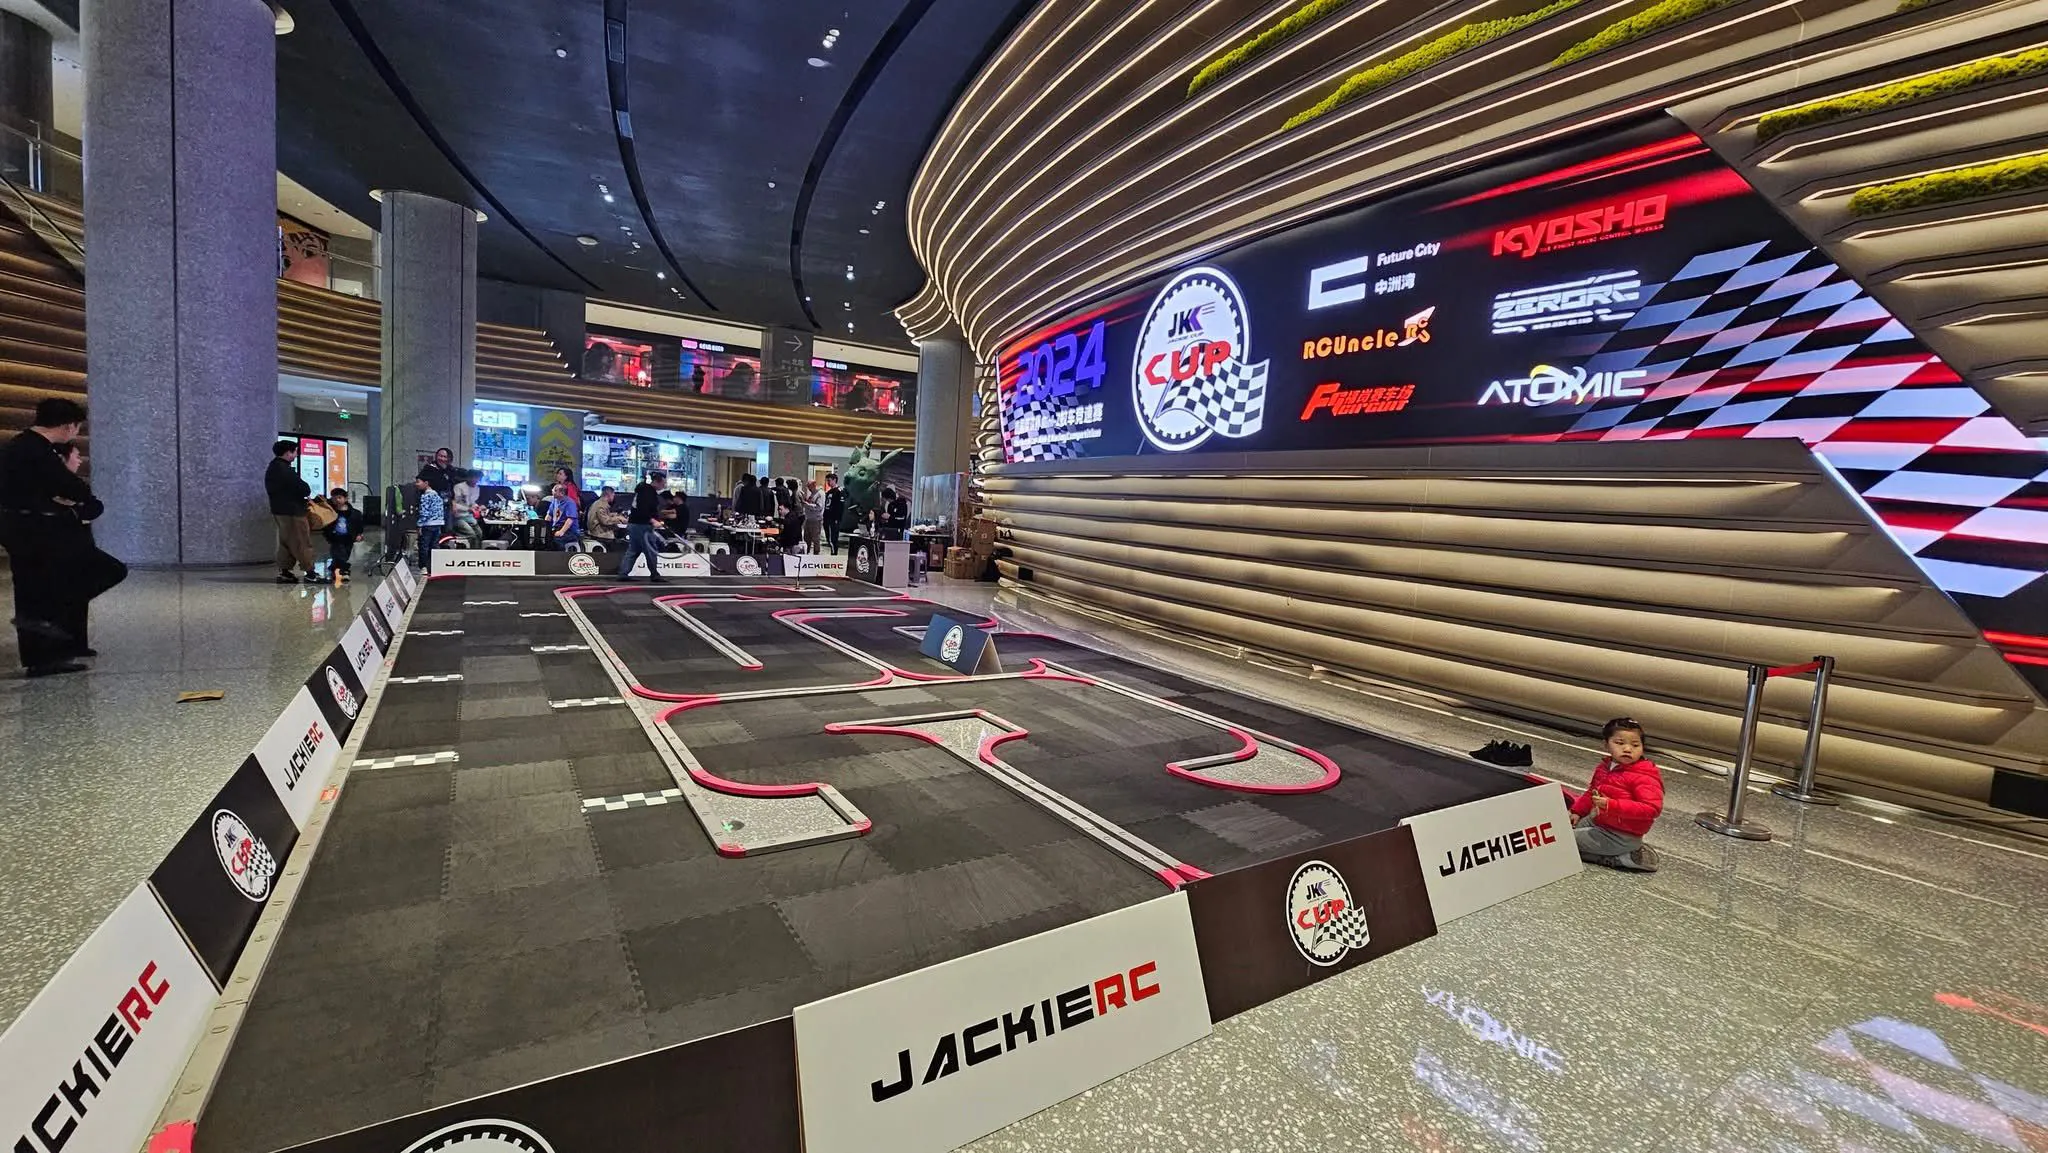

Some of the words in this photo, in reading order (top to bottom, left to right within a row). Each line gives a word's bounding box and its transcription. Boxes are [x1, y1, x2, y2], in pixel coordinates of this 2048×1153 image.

[1493, 194, 1667, 257] KYOSHO
[1377, 249, 1413, 266] Future
[1415, 242, 1440, 257] City
[1015, 321, 1106, 407] 2024
[1144, 341, 1231, 386] CUP
[1477, 364, 1647, 407] ATOMIC
[445, 560, 521, 568] JACKIERC
[284, 721, 324, 791] JACKIERC
[1439, 822, 1556, 877] JACKIERC
[1297, 899, 1345, 930] CUP
[871, 960, 1160, 1103] JACKIERC
